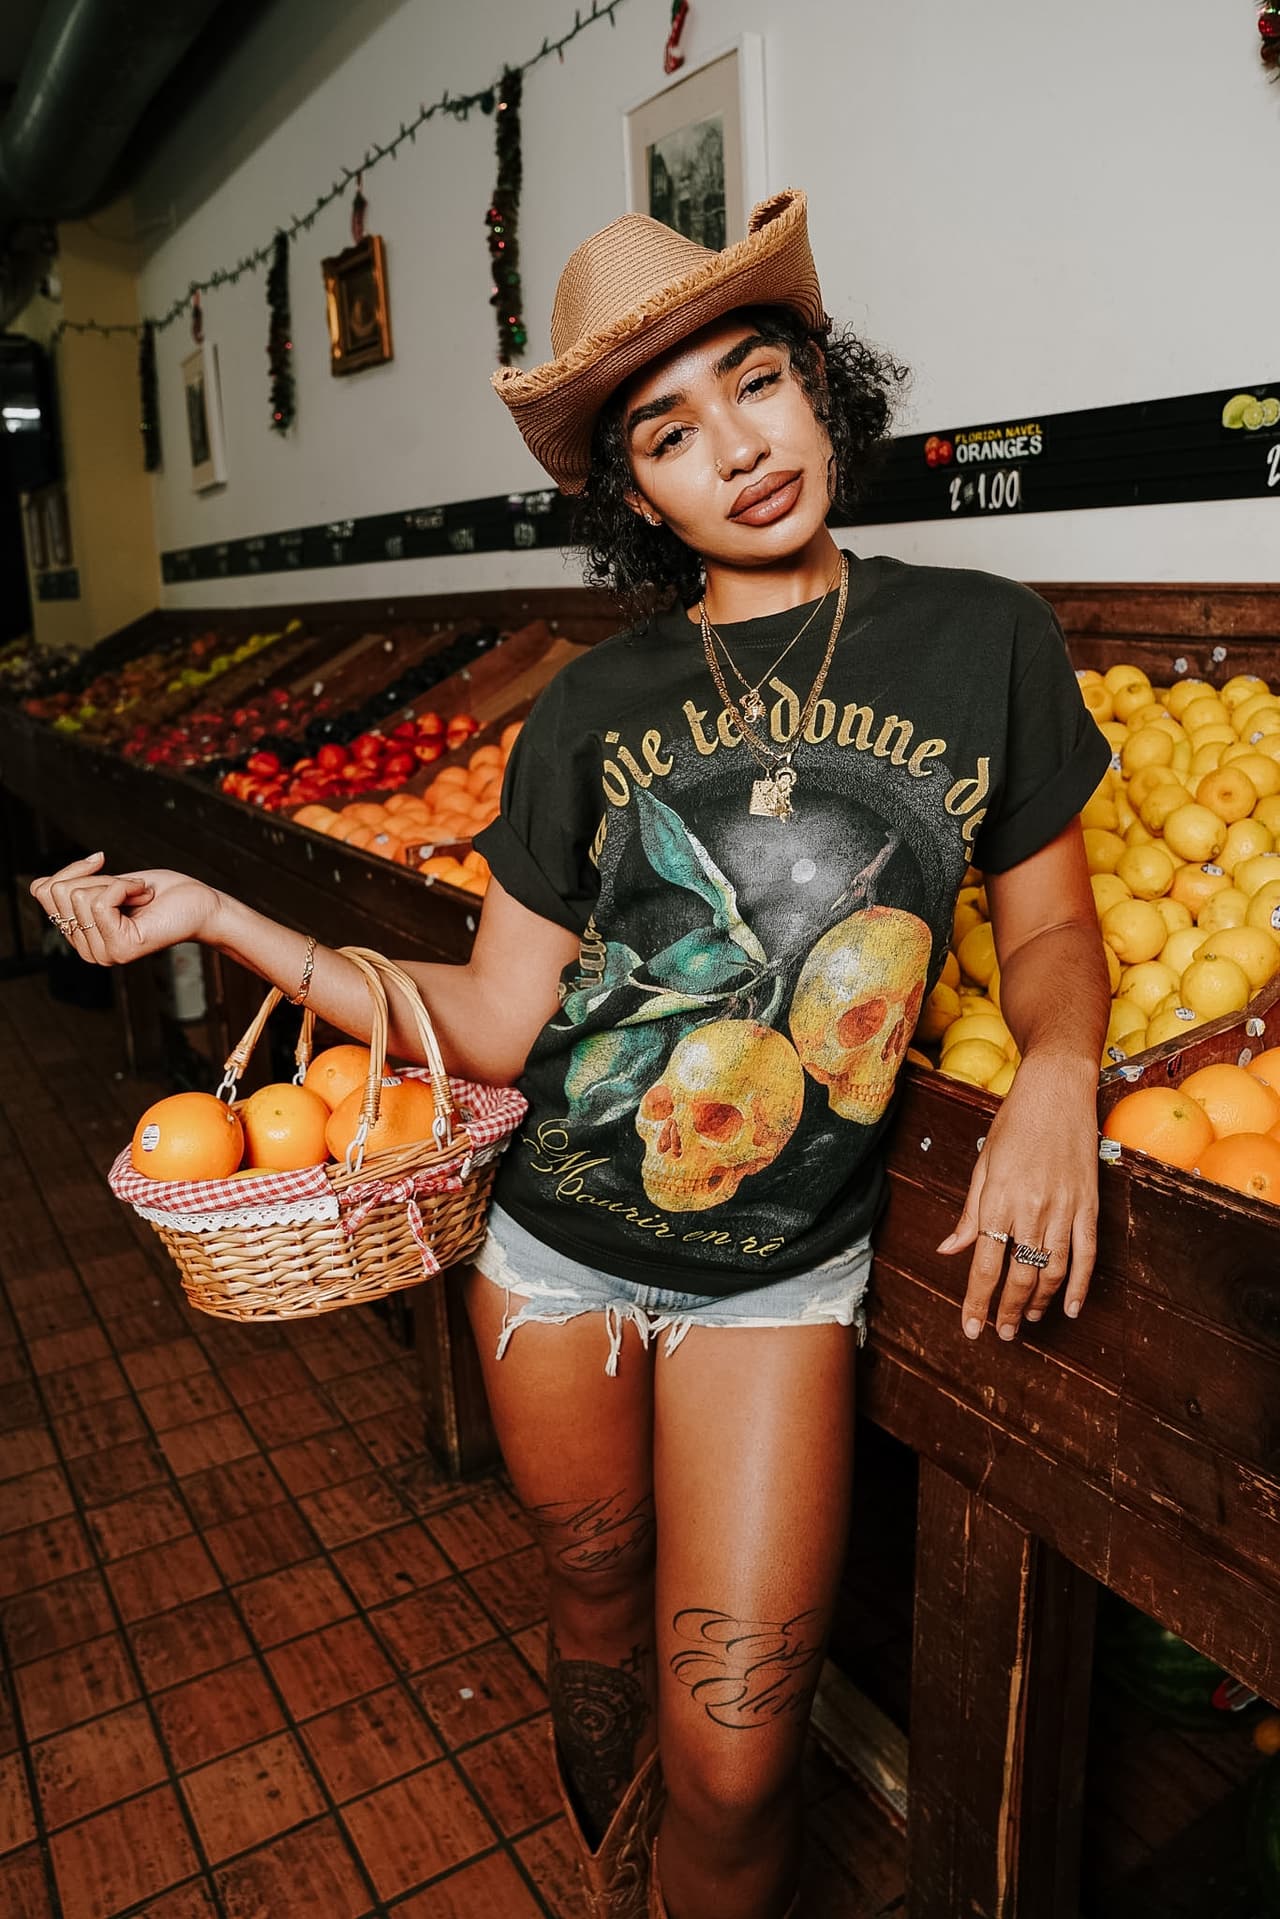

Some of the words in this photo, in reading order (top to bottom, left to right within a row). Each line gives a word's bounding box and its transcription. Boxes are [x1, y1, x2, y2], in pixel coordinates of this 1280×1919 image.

[1005, 423, 1043, 438] NAVEL
[956, 434, 1043, 463] ORANGES
[682, 699, 745, 756] te
[768, 676, 947, 778] donne
[944, 756, 991, 863] de
[682, 1228, 734, 1246] en
